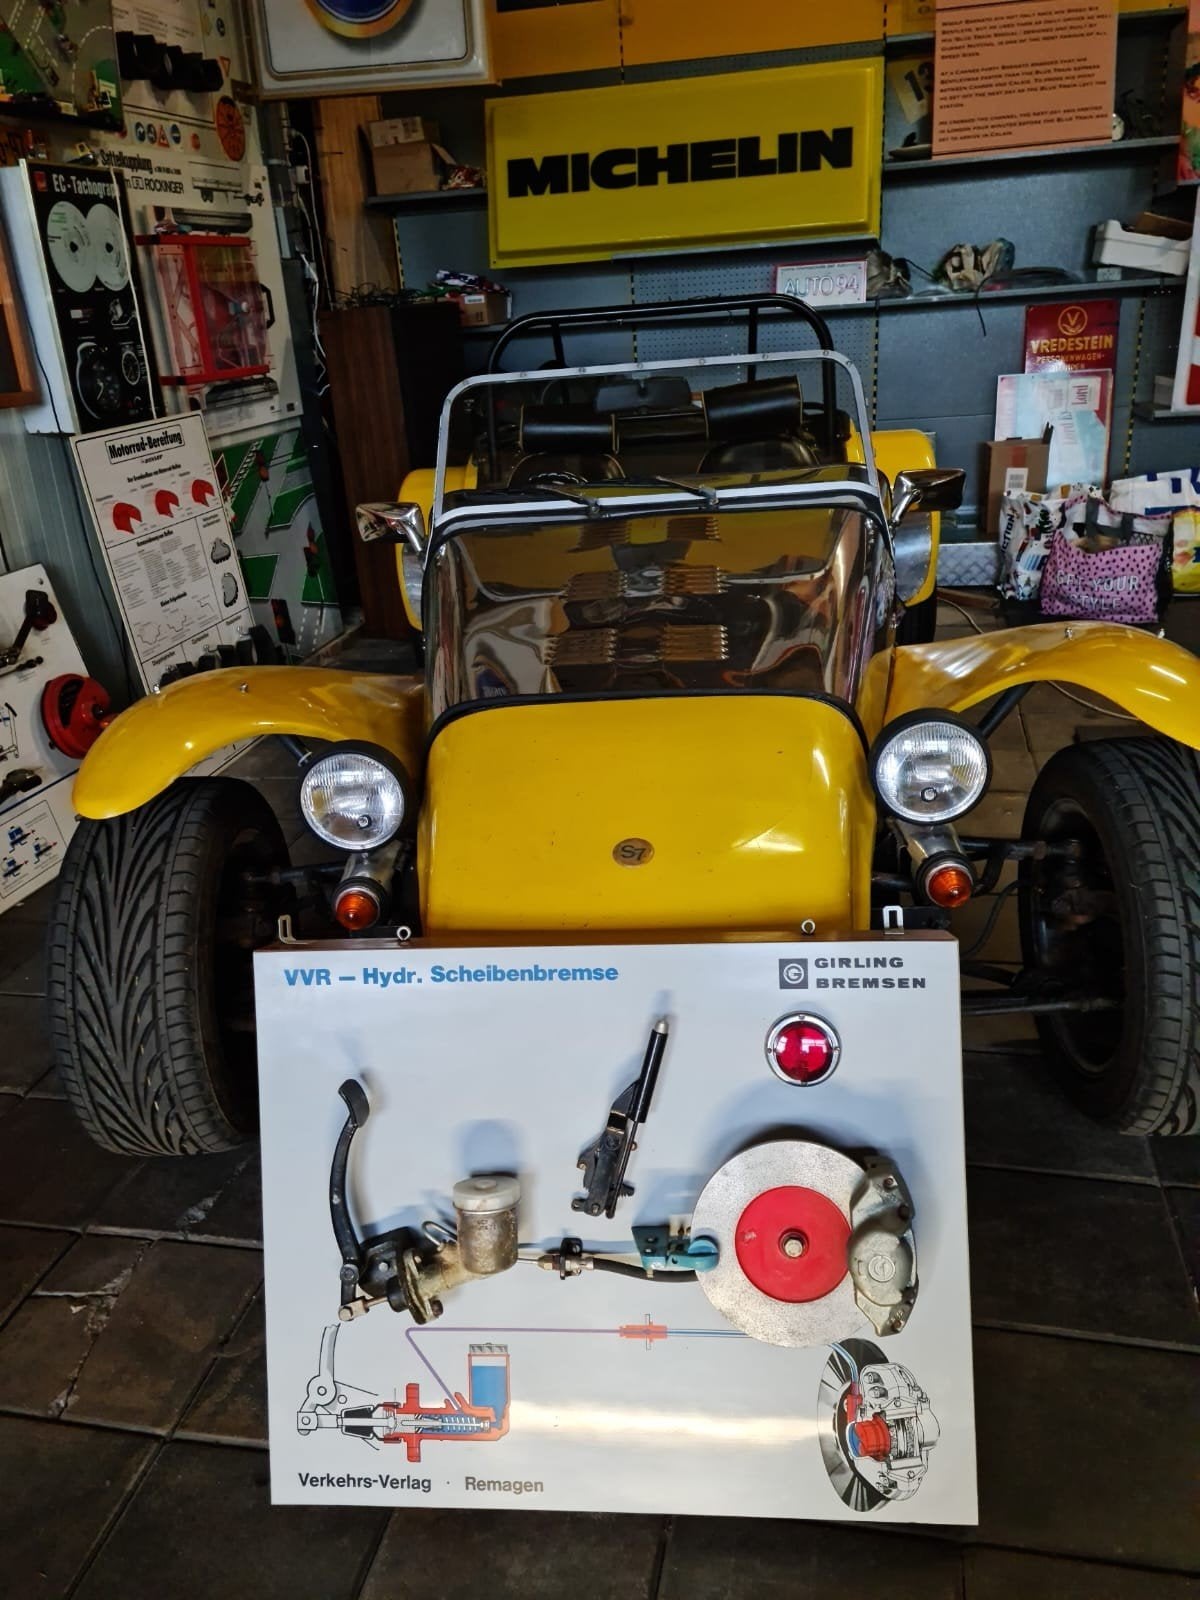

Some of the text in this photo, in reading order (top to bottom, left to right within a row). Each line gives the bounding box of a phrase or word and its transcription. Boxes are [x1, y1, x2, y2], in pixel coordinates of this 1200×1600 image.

[508, 127, 852, 199] MICHELIN
[784, 273, 859, 297] AUTO 94
[1030, 334, 1113, 354] VREDESTEIN
[108, 430, 182, 459] Motorrad-Bereifung
[1055, 570, 1140, 591] GET YOUR
[814, 956, 904, 969] GIRLING
[284, 968, 333, 987] VVR
[362, 966, 423, 988] Hydr.
[430, 964, 619, 983] Scheibenbremse
[816, 976, 926, 989] BREMSEN
[298, 1472, 544, 1495] Verkehrs-Verlag Remagen
